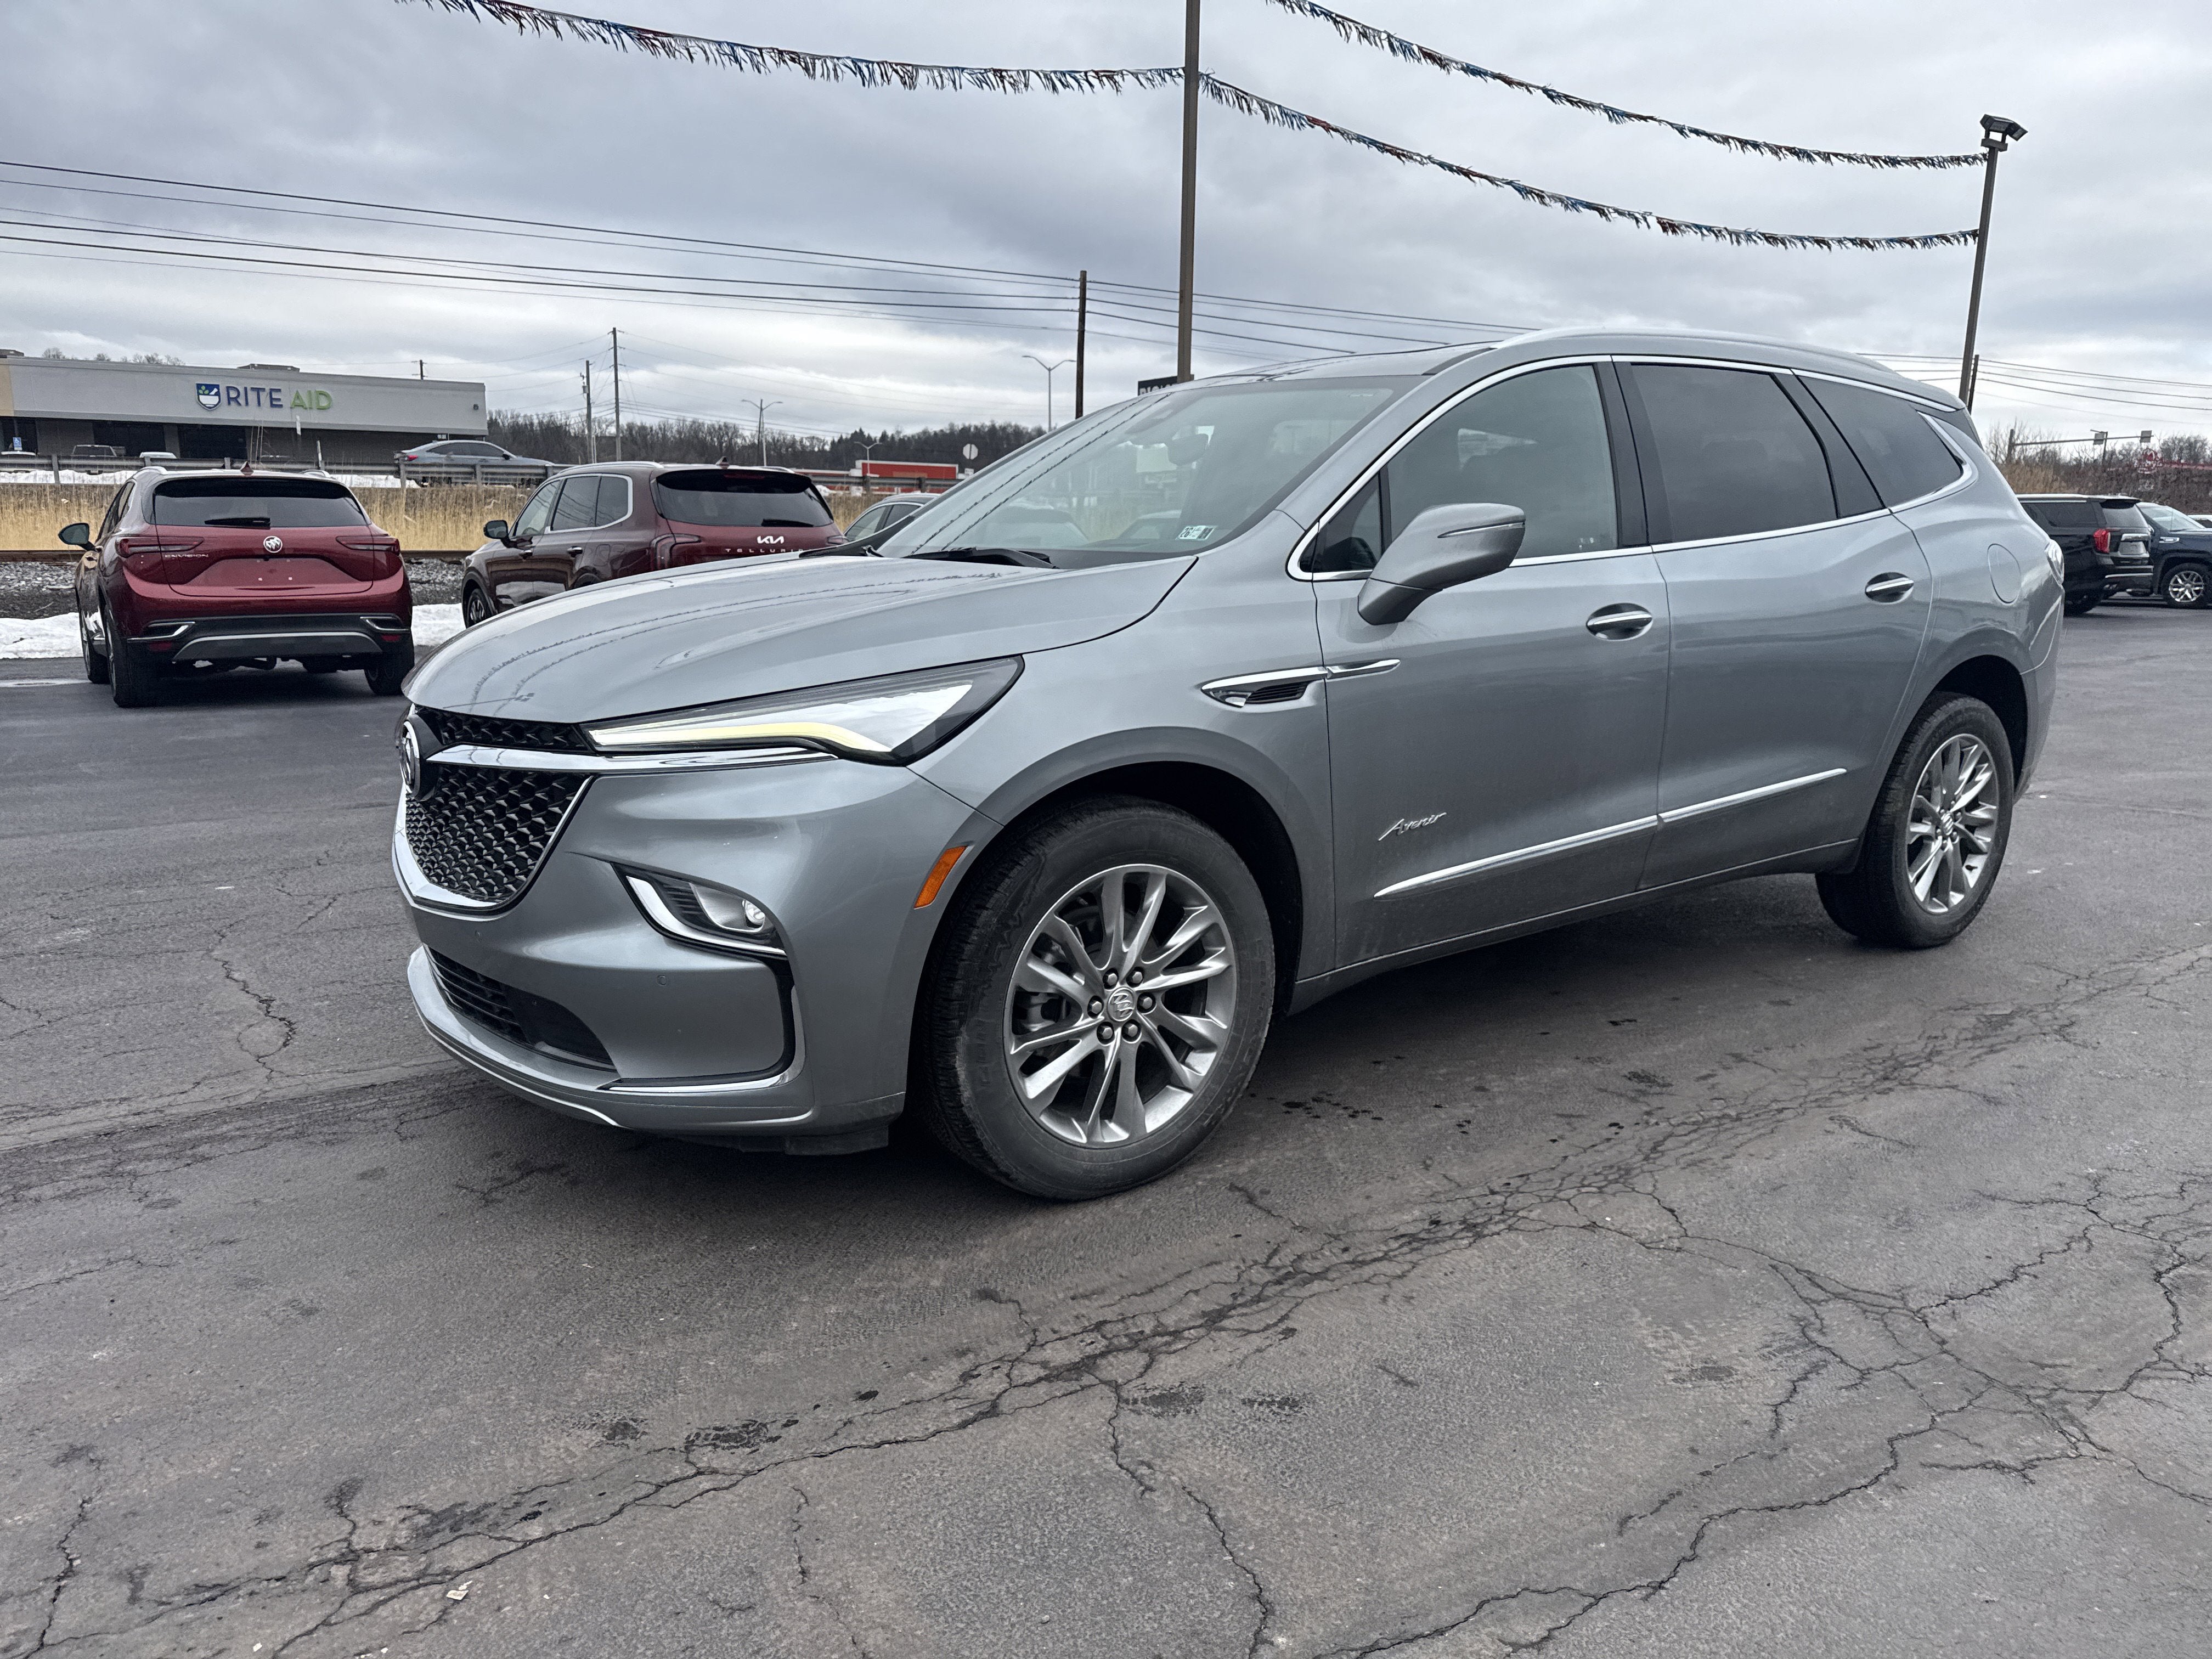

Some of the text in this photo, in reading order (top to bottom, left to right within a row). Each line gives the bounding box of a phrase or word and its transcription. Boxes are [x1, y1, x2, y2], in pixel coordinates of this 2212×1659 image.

[226, 386, 332, 410] RITE AID
[757, 535, 785, 544] KIA
[1378, 812, 1447, 842] Avenir
